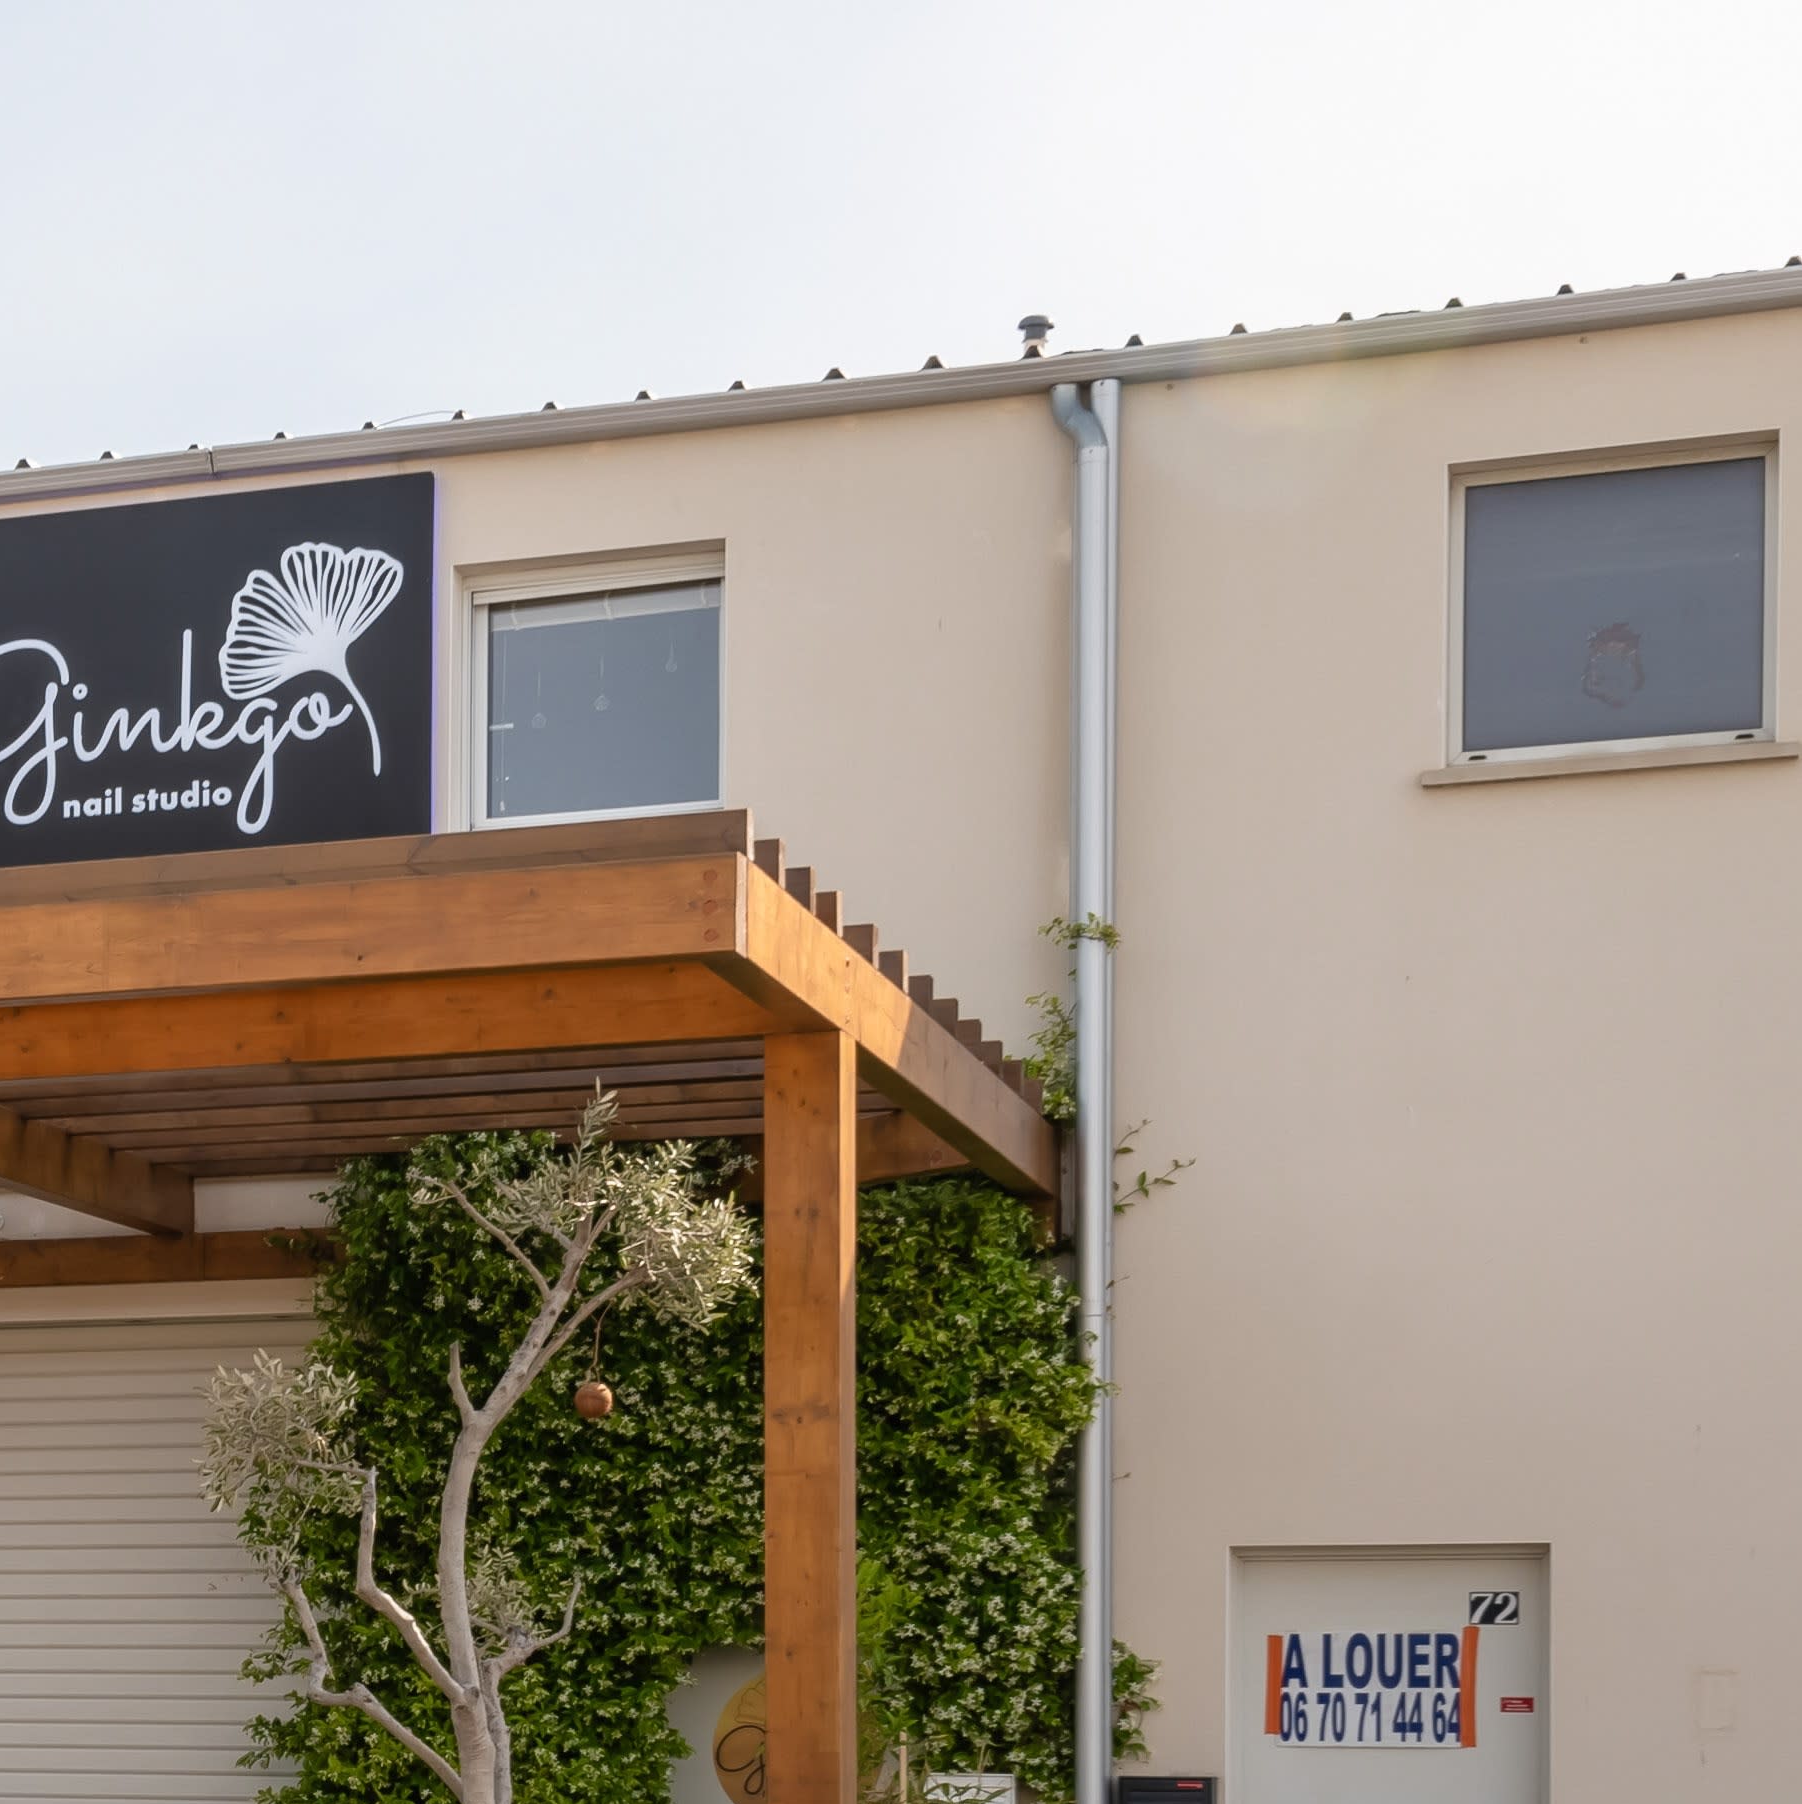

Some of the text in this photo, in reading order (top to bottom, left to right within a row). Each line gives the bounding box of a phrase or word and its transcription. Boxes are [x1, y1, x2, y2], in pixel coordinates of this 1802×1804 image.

[63, 780, 233, 818] nail studio
[1469, 1593, 1518, 1624] 72
[1281, 1632, 1461, 1689] A LOUER
[1280, 1692, 1461, 1742] 06 70 71 44 64
